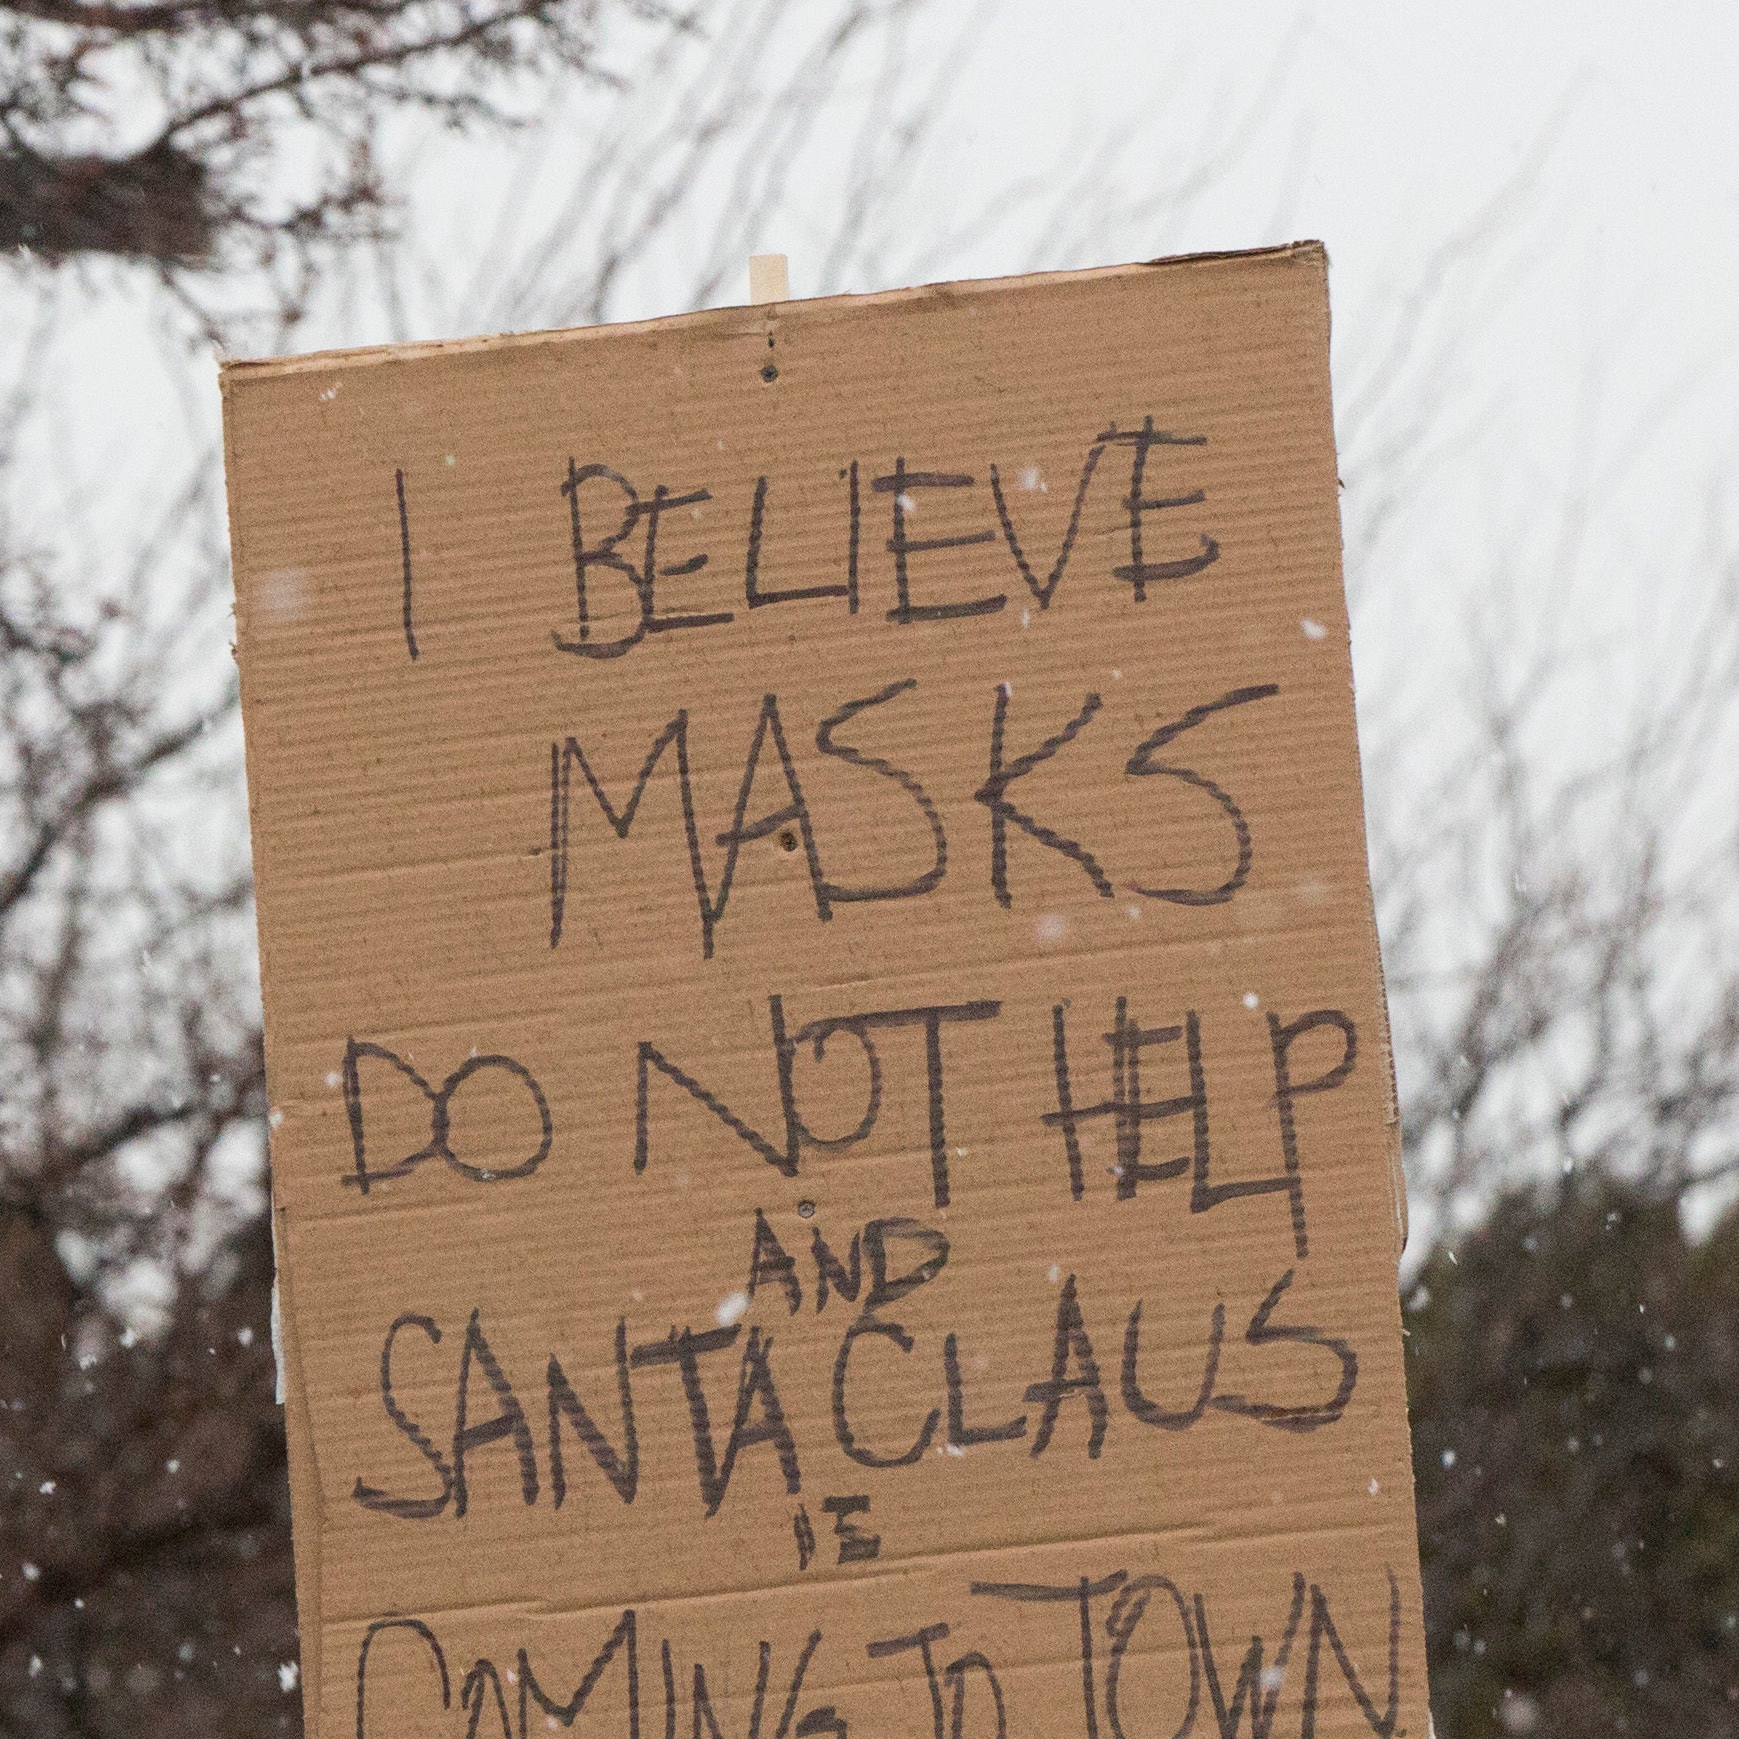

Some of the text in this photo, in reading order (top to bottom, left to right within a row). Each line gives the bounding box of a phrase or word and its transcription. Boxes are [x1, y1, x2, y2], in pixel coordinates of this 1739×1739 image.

[392, 412, 1221, 661] I BELIEVE
[545, 677, 1281, 961] MASKS
[341, 992, 1359, 1259] DO NOT HELP
[747, 1206, 952, 1316] AND
[353, 1268, 1359, 1520] SANTA CLAUS
